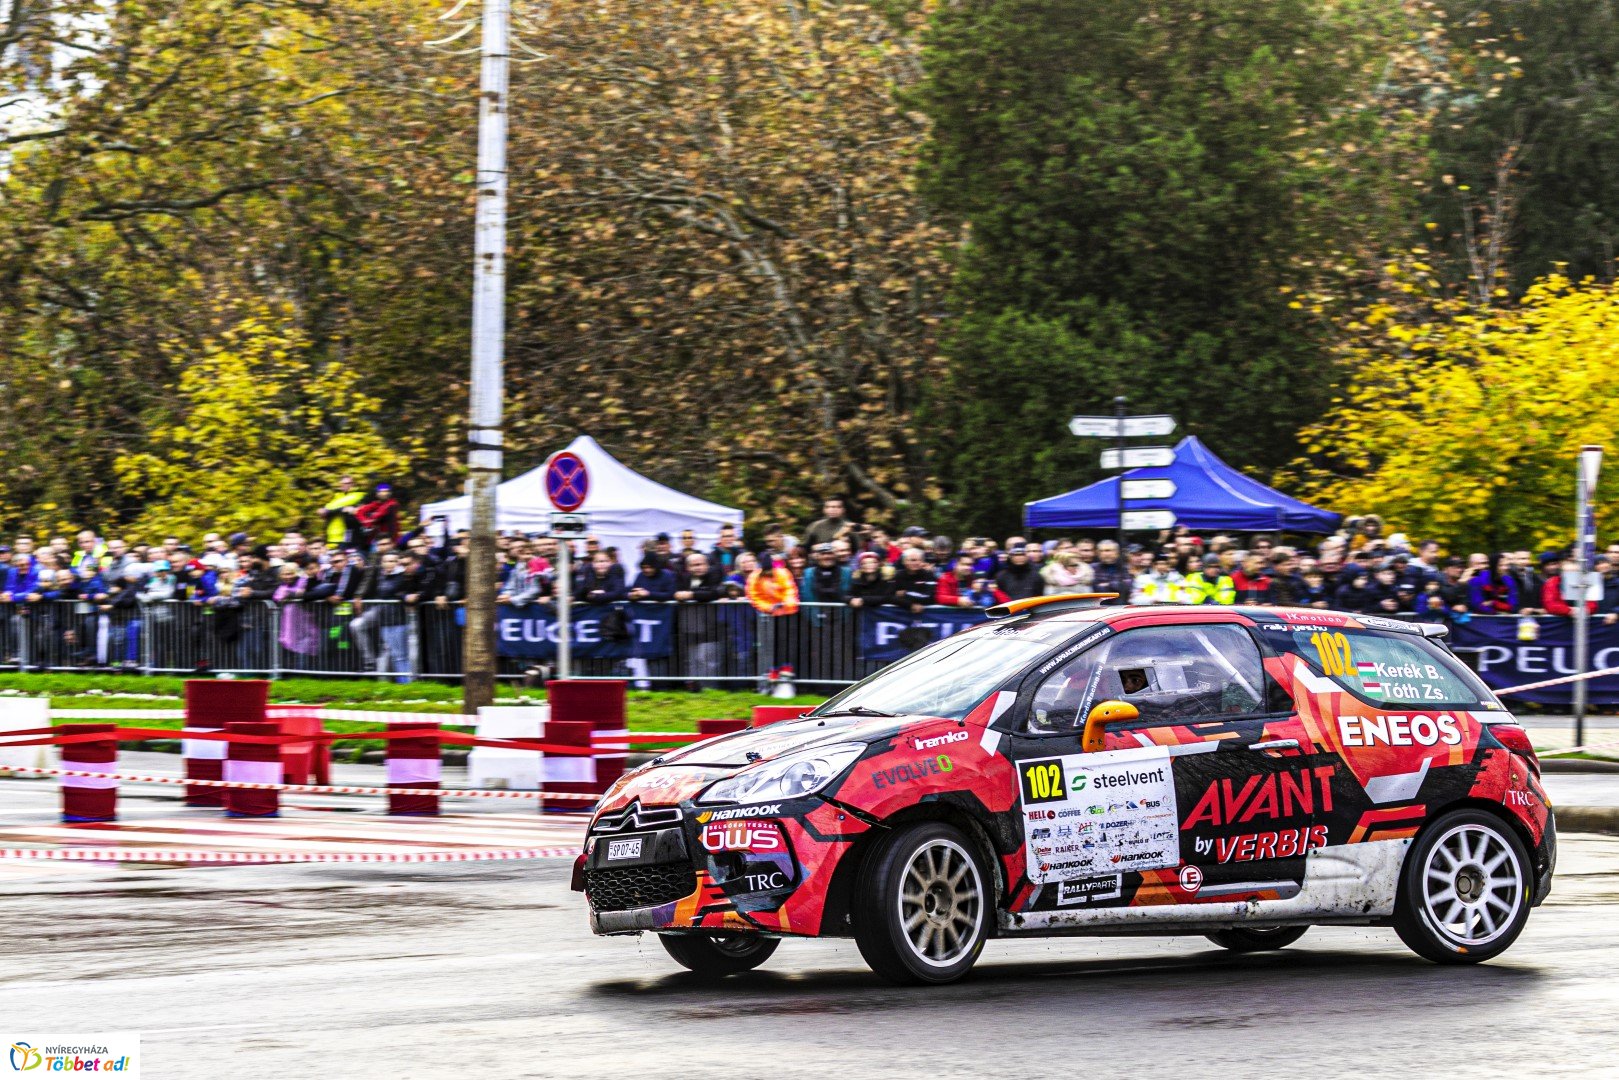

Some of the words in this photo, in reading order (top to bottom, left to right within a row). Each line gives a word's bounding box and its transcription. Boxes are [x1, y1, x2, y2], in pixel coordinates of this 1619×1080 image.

[495, 618, 662, 642] EUGET
[1310, 632, 1358, 677] 102
[1374, 662, 1424, 679] Kerék
[1425, 665, 1444, 680] B.
[1380, 682, 1420, 699] Tóth
[1422, 684, 1449, 700] Zs.
[1338, 715, 1462, 747] ENEOS
[1026, 765, 1063, 798] 102
[1093, 768, 1164, 789] steelvent
[1180, 765, 1335, 831] AVANT
[1508, 790, 1534, 806] TRC
[1028, 810, 1047, 820] HELL
[1058, 810, 1081, 818] COFFEE
[1106, 821, 1128, 829] DOZER
[1195, 837, 1213, 855] by
[1216, 825, 1328, 864] VERBIS
[744, 872, 784, 890] TRC
[1186, 871, 1197, 885] E
[1063, 880, 1117, 895] RALLYPARTS
